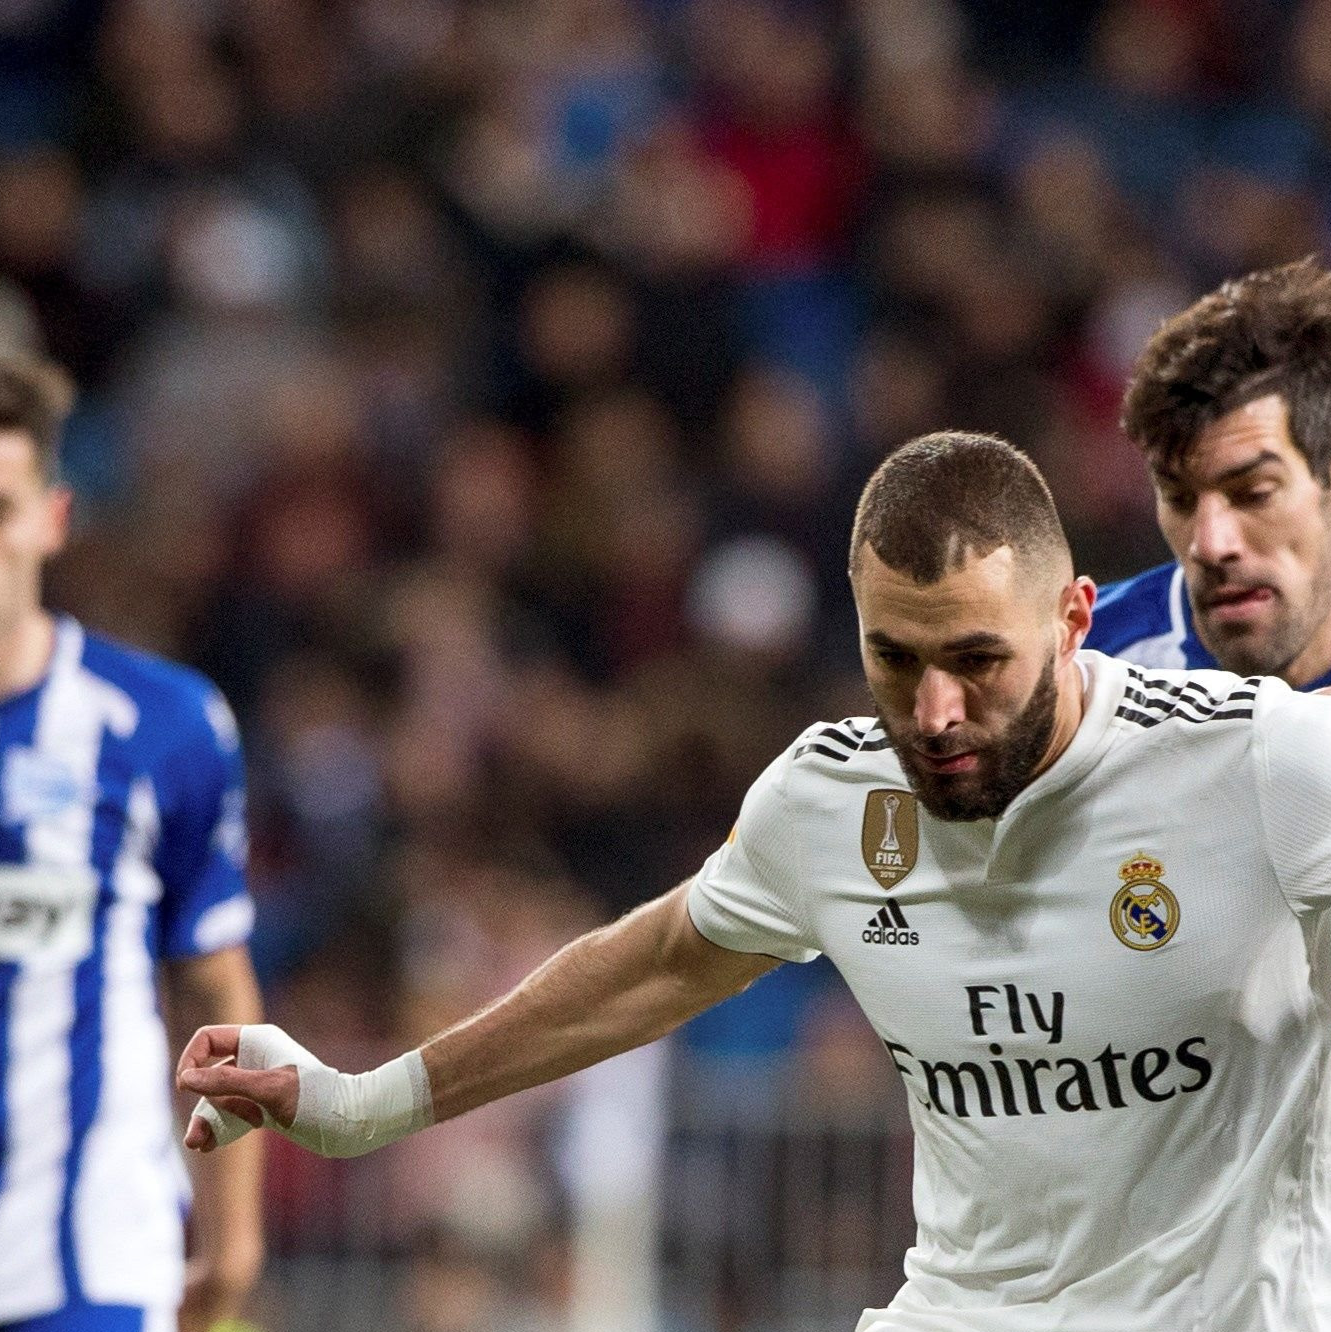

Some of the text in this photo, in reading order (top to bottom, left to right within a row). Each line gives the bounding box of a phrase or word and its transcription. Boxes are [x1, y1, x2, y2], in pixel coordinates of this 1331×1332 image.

[875, 852, 903, 866] FIFA
[861, 927, 920, 946] adidas
[963, 983, 1065, 1045] Fly
